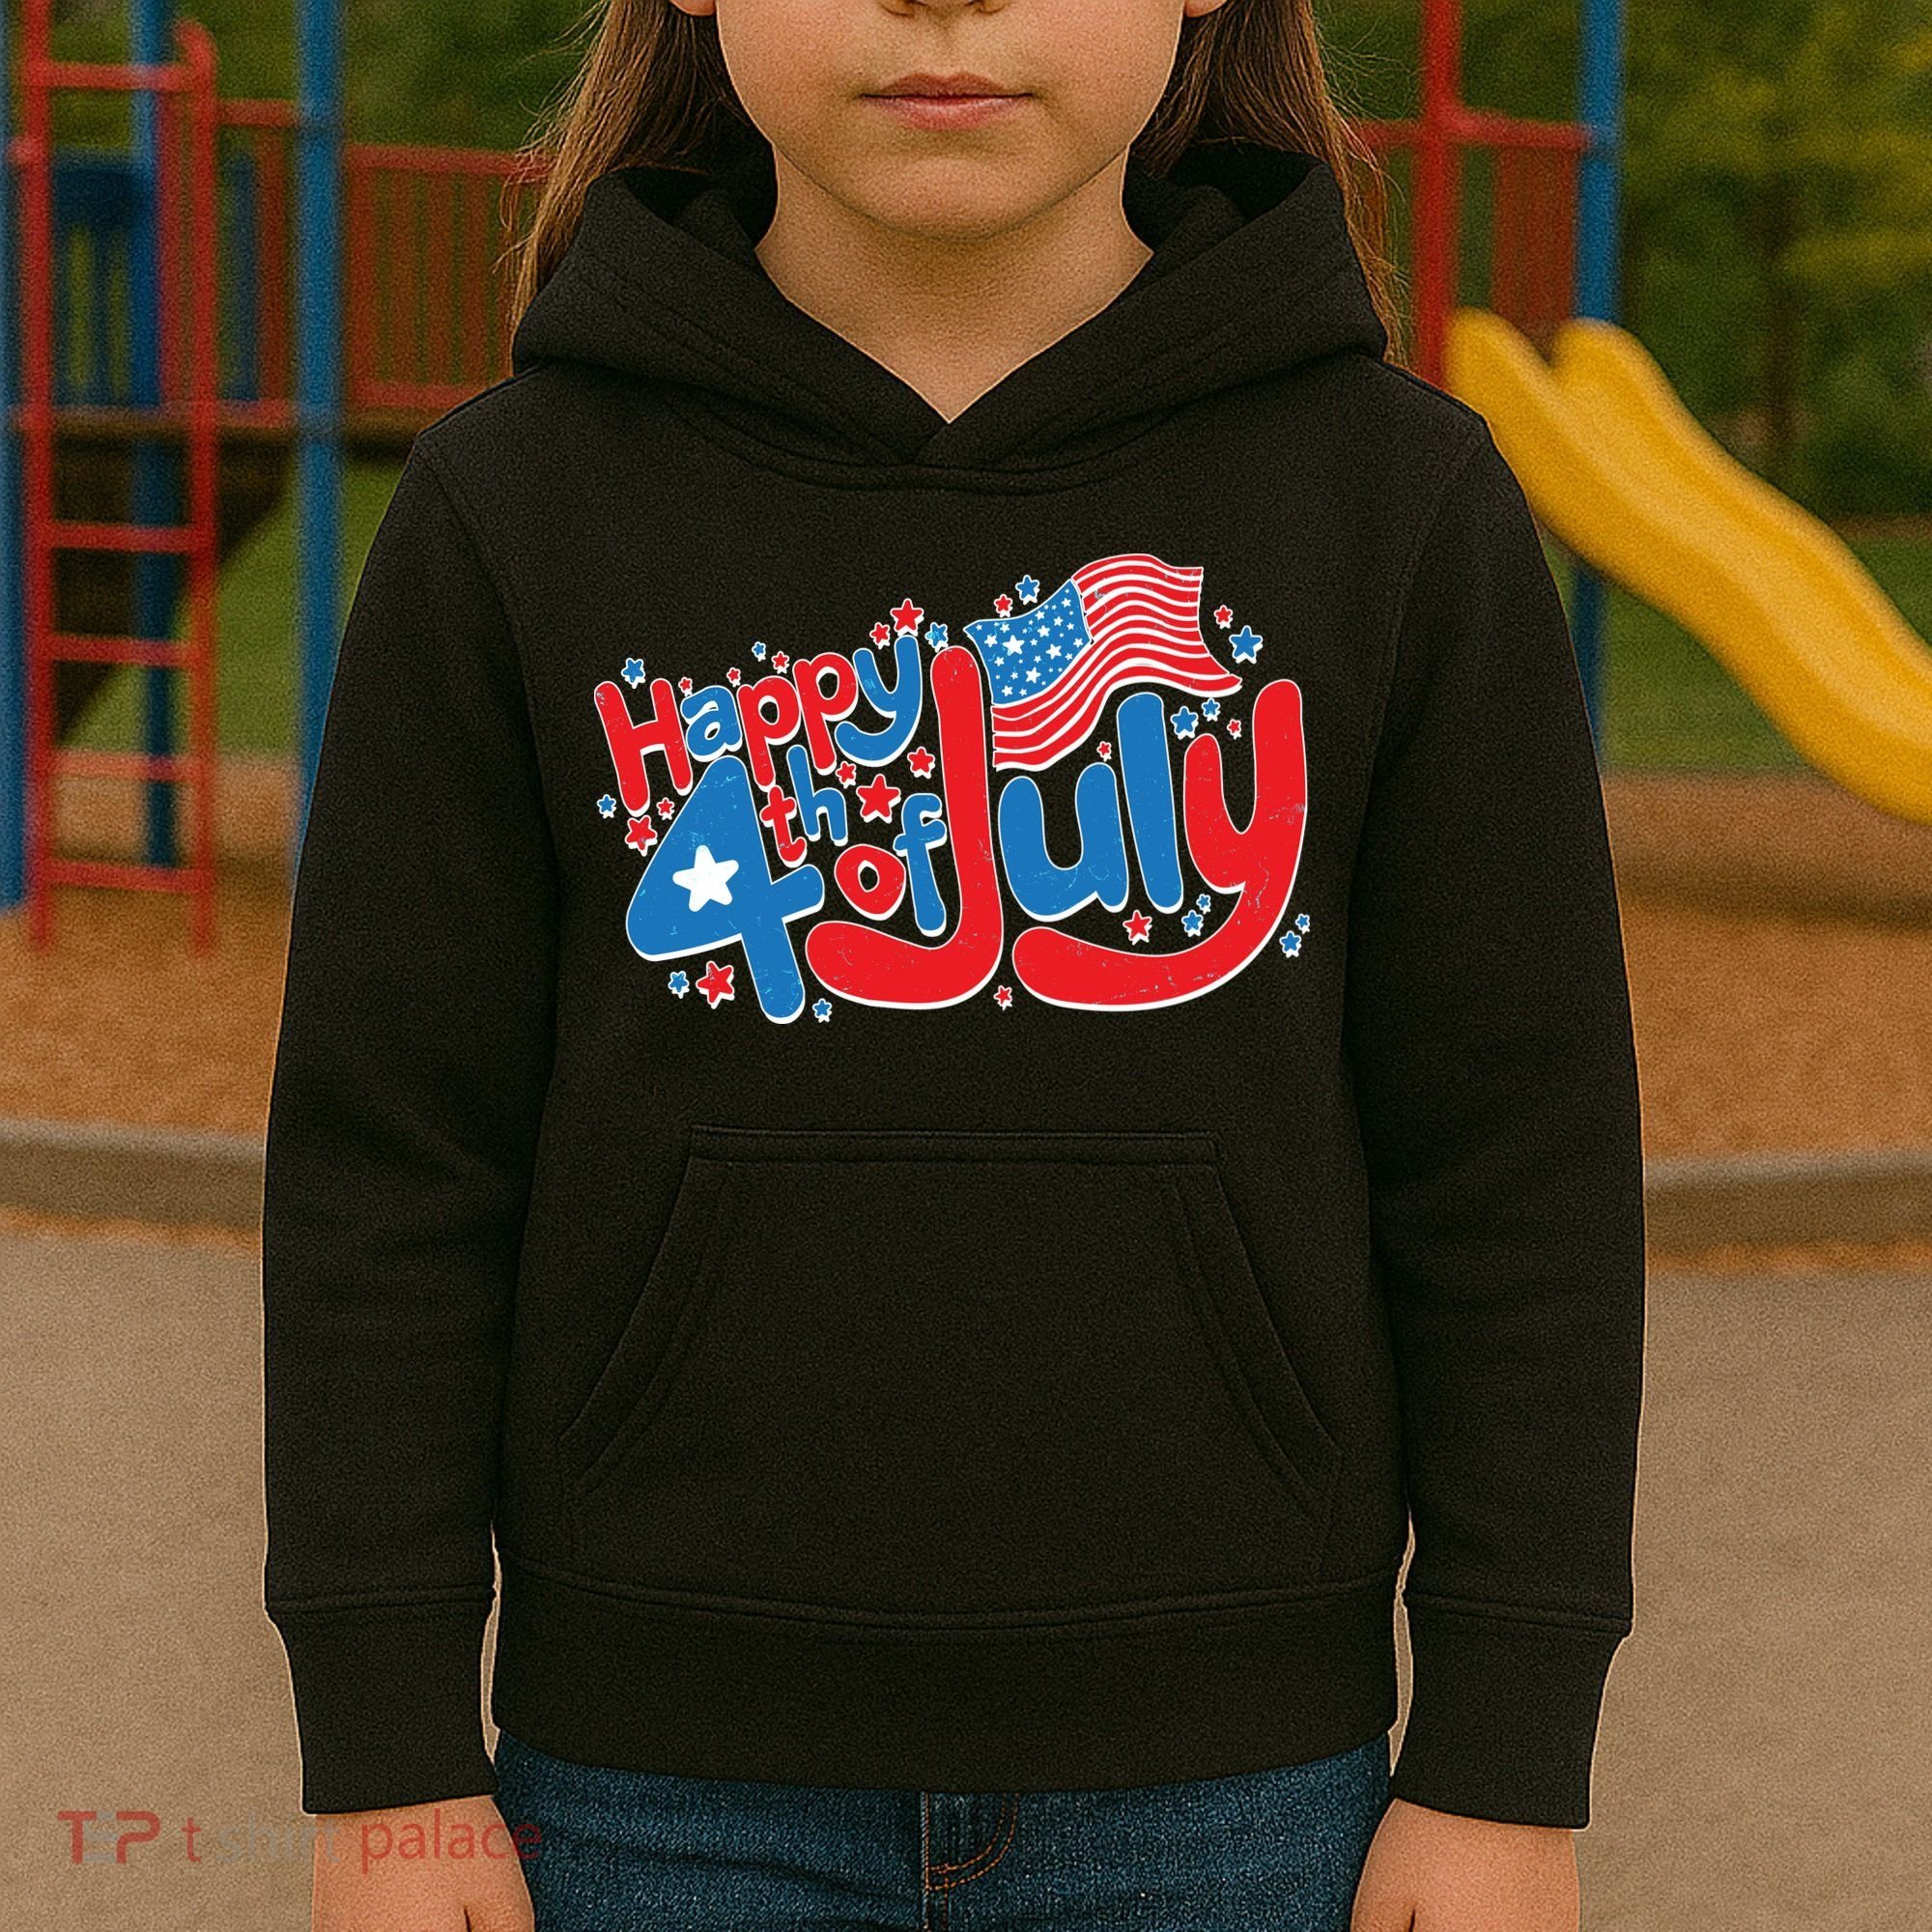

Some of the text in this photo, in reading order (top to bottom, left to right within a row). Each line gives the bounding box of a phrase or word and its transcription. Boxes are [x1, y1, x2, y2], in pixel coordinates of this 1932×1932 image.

[593, 634, 923, 815] Happy
[625, 644, 1308, 1024] 4th of July
